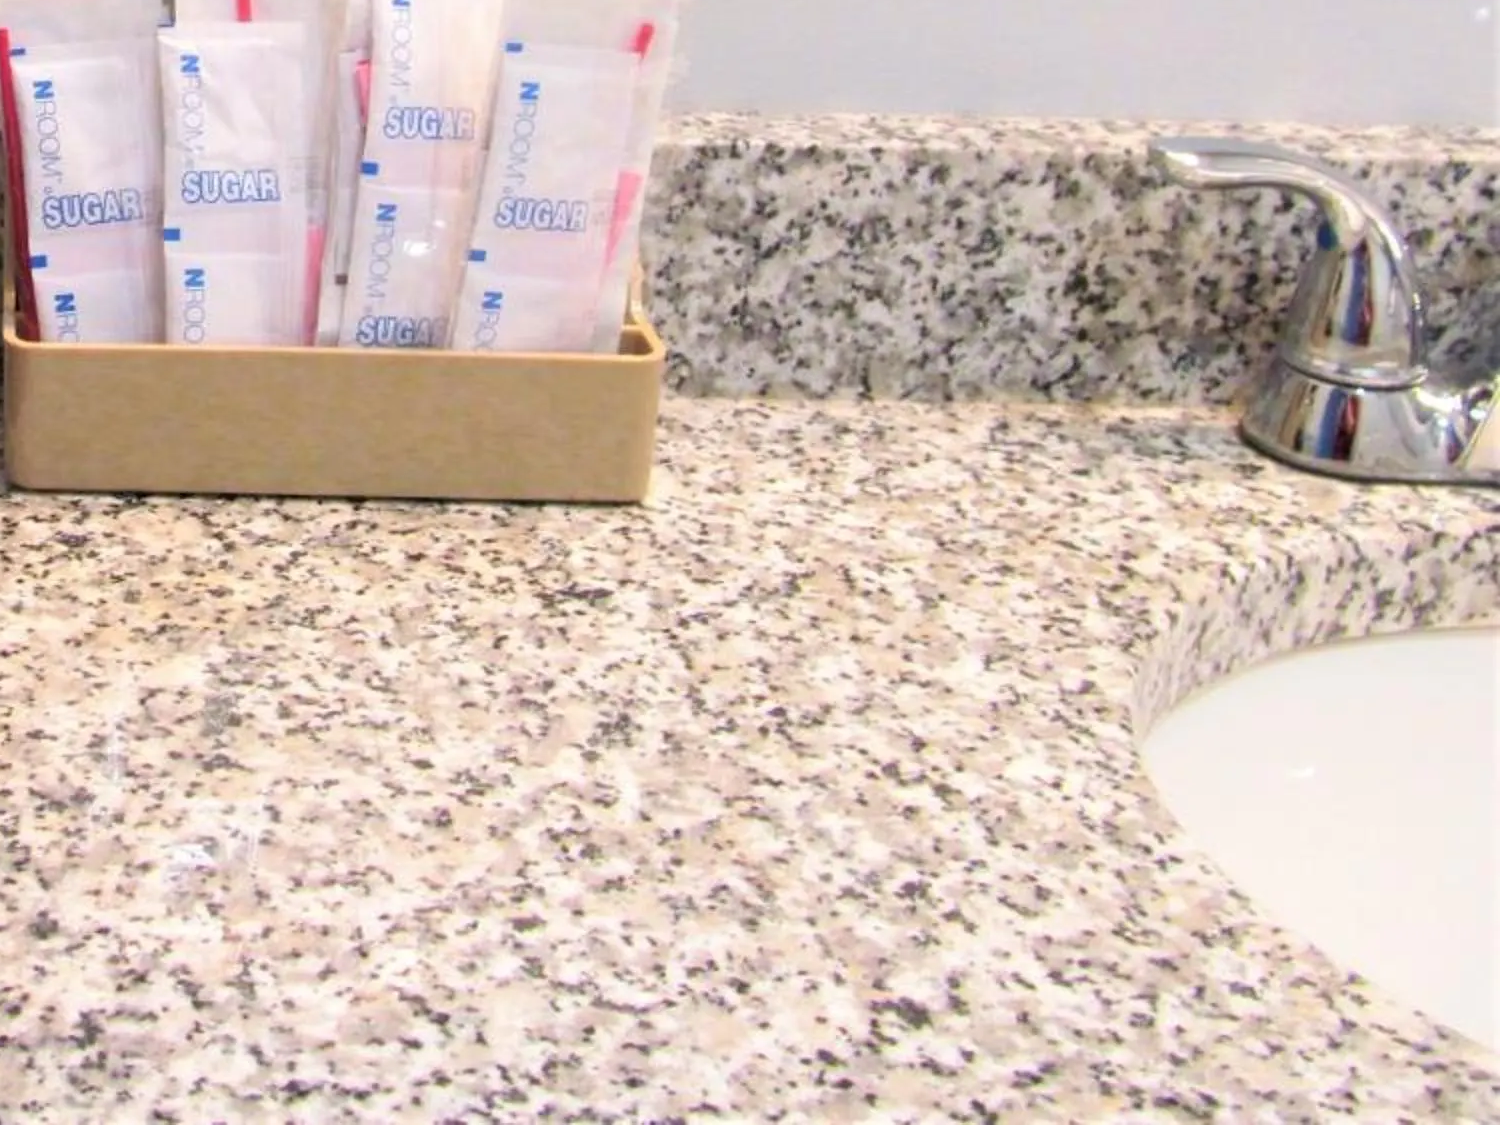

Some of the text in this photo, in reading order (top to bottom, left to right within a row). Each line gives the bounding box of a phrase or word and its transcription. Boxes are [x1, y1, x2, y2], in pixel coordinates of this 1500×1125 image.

[384, 107, 476, 141] SUGAR
[181, 170, 281, 204] SUGAR
[42, 189, 143, 229] SUGAR
[495, 196, 588, 232] SUGAR
[184, 269, 206, 344] NROO
